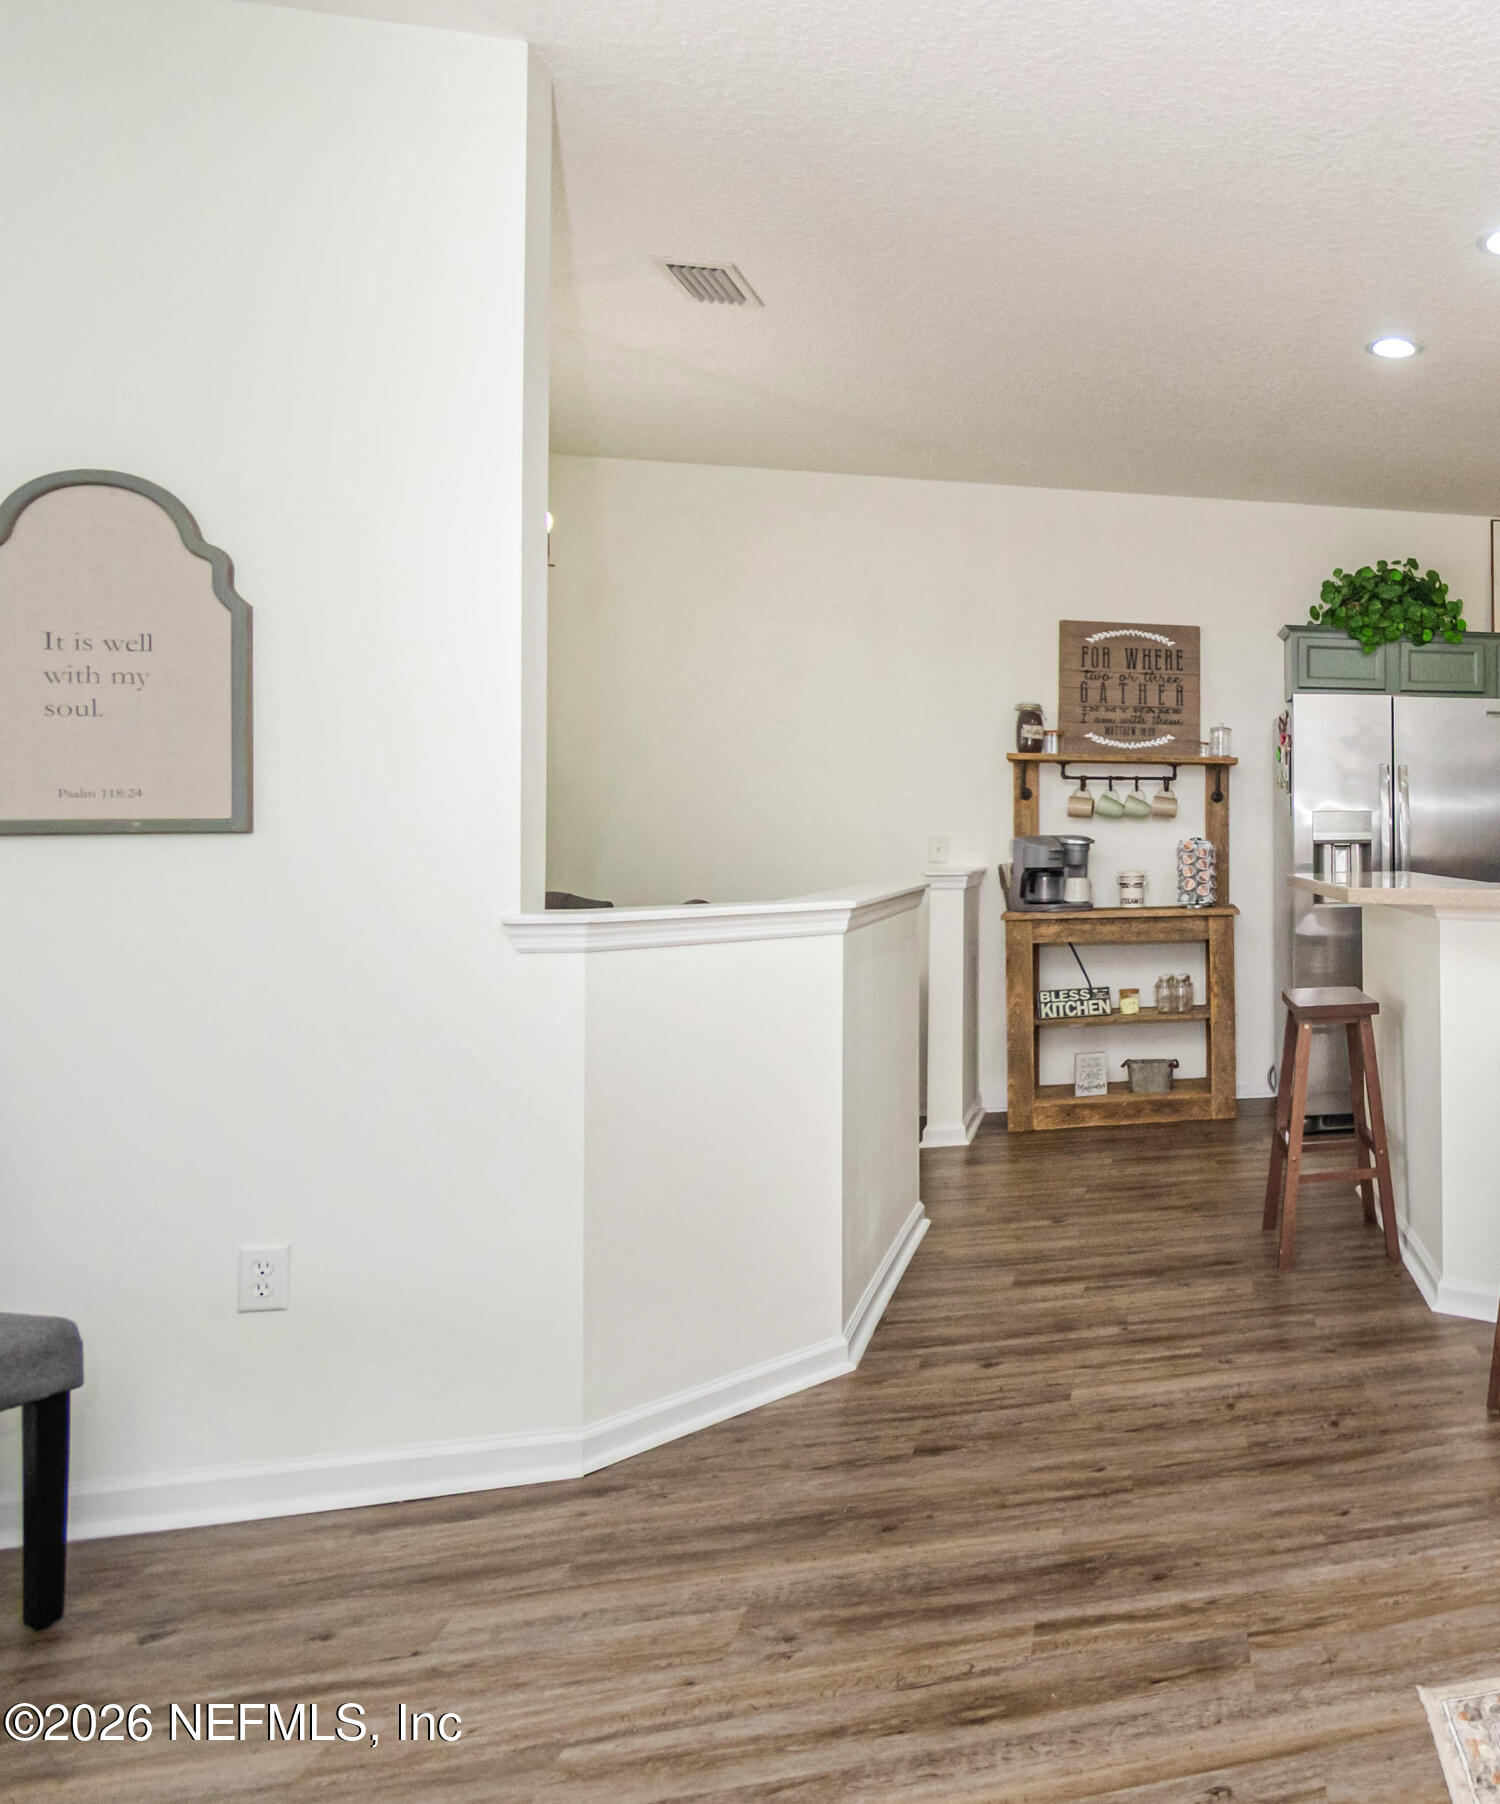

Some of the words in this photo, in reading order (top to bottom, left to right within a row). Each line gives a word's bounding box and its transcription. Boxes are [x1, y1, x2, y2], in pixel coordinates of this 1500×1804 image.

[42, 631, 65, 651] It
[74, 632, 93, 651] is
[103, 633, 153, 652] well
[1081, 646, 1111, 669] FOR
[1125, 647, 1184, 671] WHERE
[43, 664, 101, 684] with
[111, 671, 151, 692] my
[1081, 669, 1113, 681] two
[1119, 673, 1138, 682] or
[1141, 670, 1183, 684] three
[1080, 681, 1184, 706] GATHER
[44, 698, 104, 717] soul.
[57, 787, 97, 799] Psalm
[1040, 989, 1091, 1003] BLESS
[1041, 999, 1112, 1019] KITCHEN
